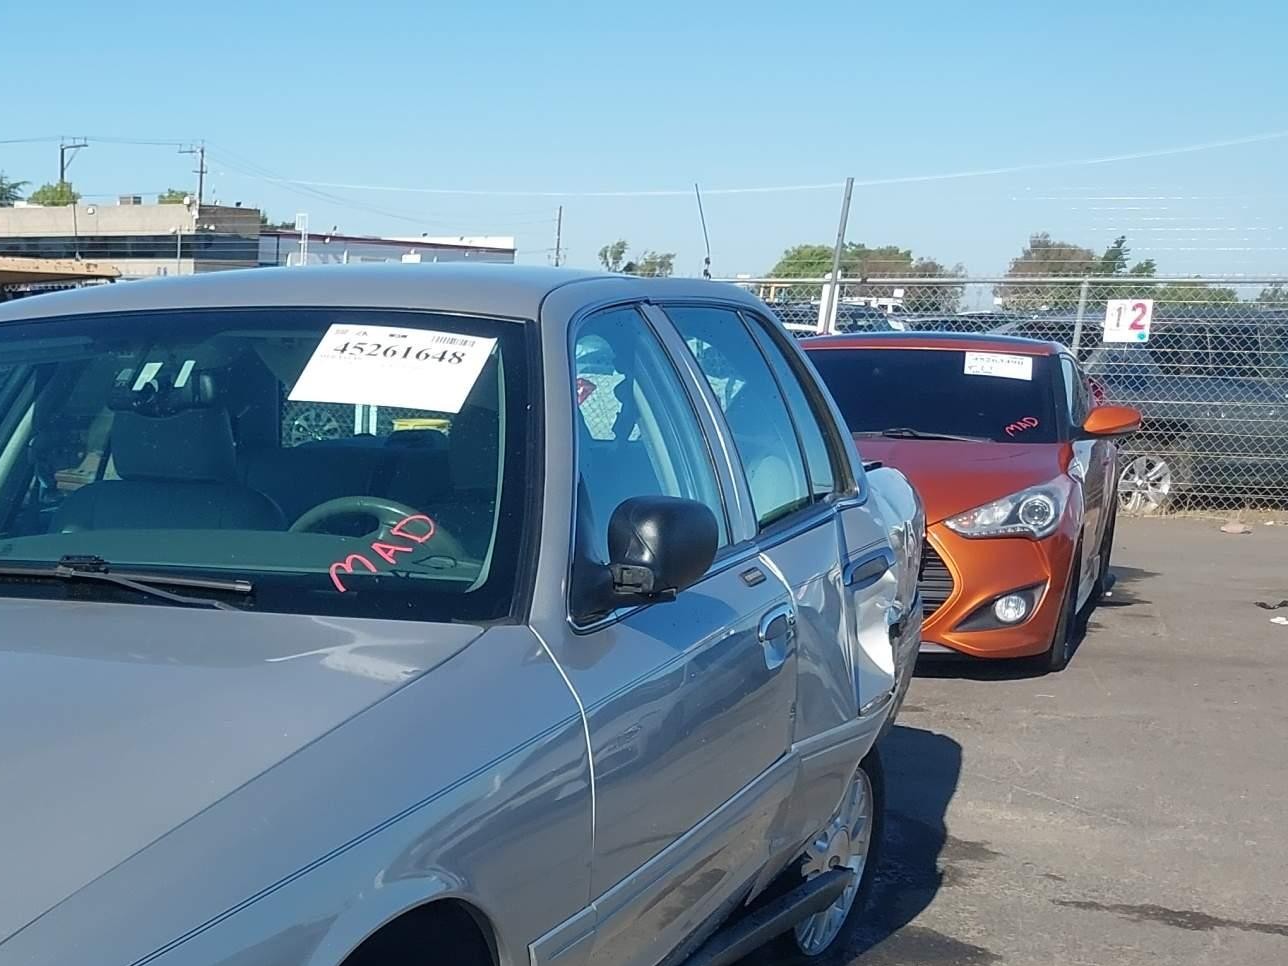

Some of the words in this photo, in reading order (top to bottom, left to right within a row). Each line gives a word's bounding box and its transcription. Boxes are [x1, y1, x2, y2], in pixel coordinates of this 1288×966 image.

[333, 341, 466, 366] 45261648
[1004, 416, 1040, 438] MAD
[328, 513, 436, 593] MAD
